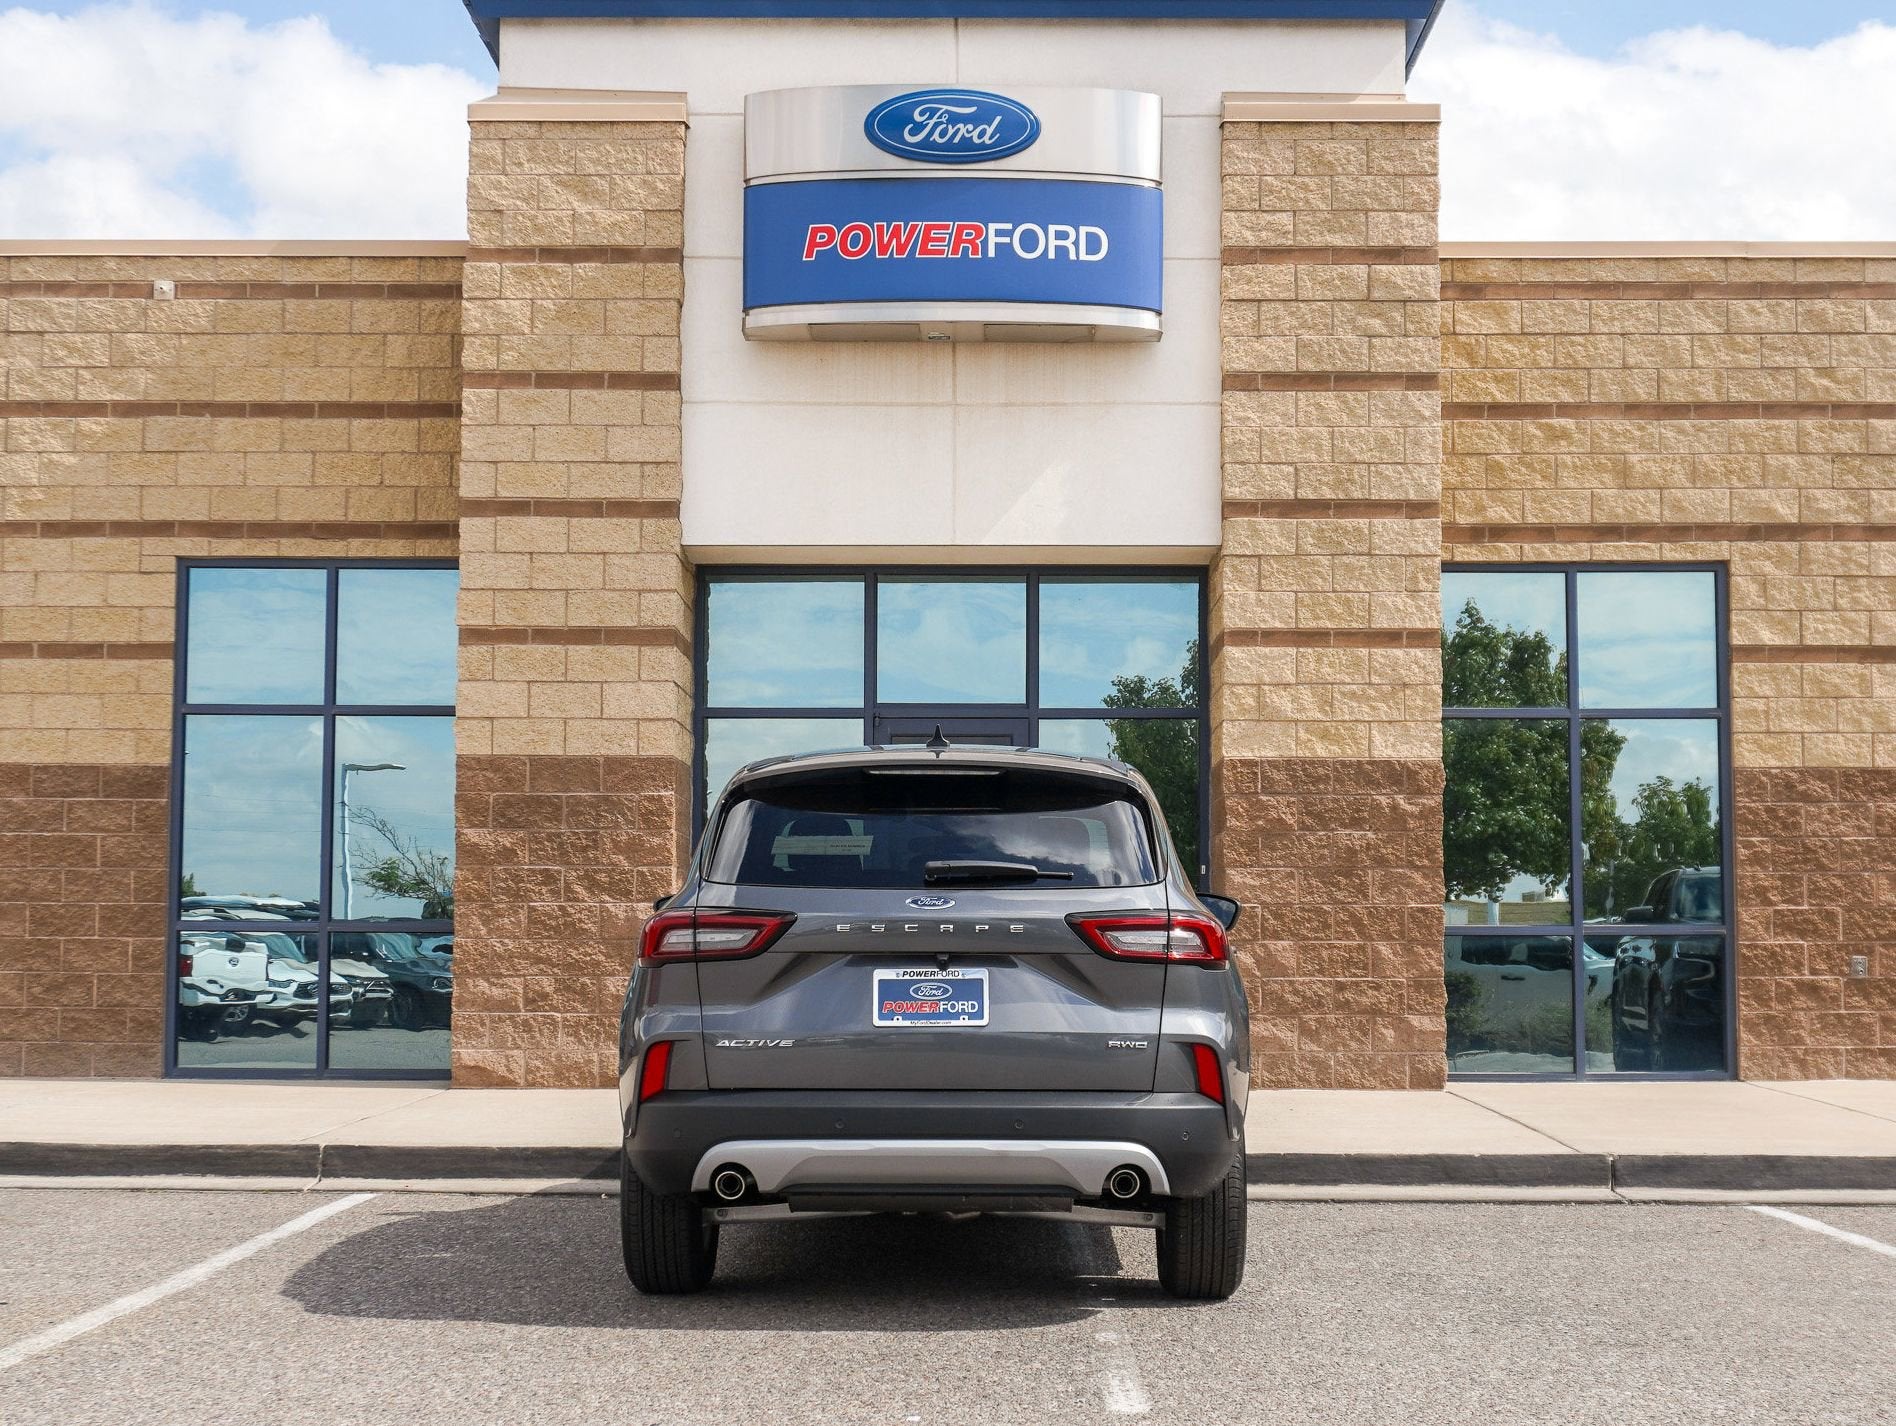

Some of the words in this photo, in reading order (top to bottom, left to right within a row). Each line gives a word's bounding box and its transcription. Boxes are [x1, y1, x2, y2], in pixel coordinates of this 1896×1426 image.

[903, 104, 1002, 145] Ford
[918, 896, 944, 906] Ford
[836, 924, 1024, 933] ESCAPE
[918, 985, 943, 996] Ford
[715, 1039, 796, 1047] ACTIVE
